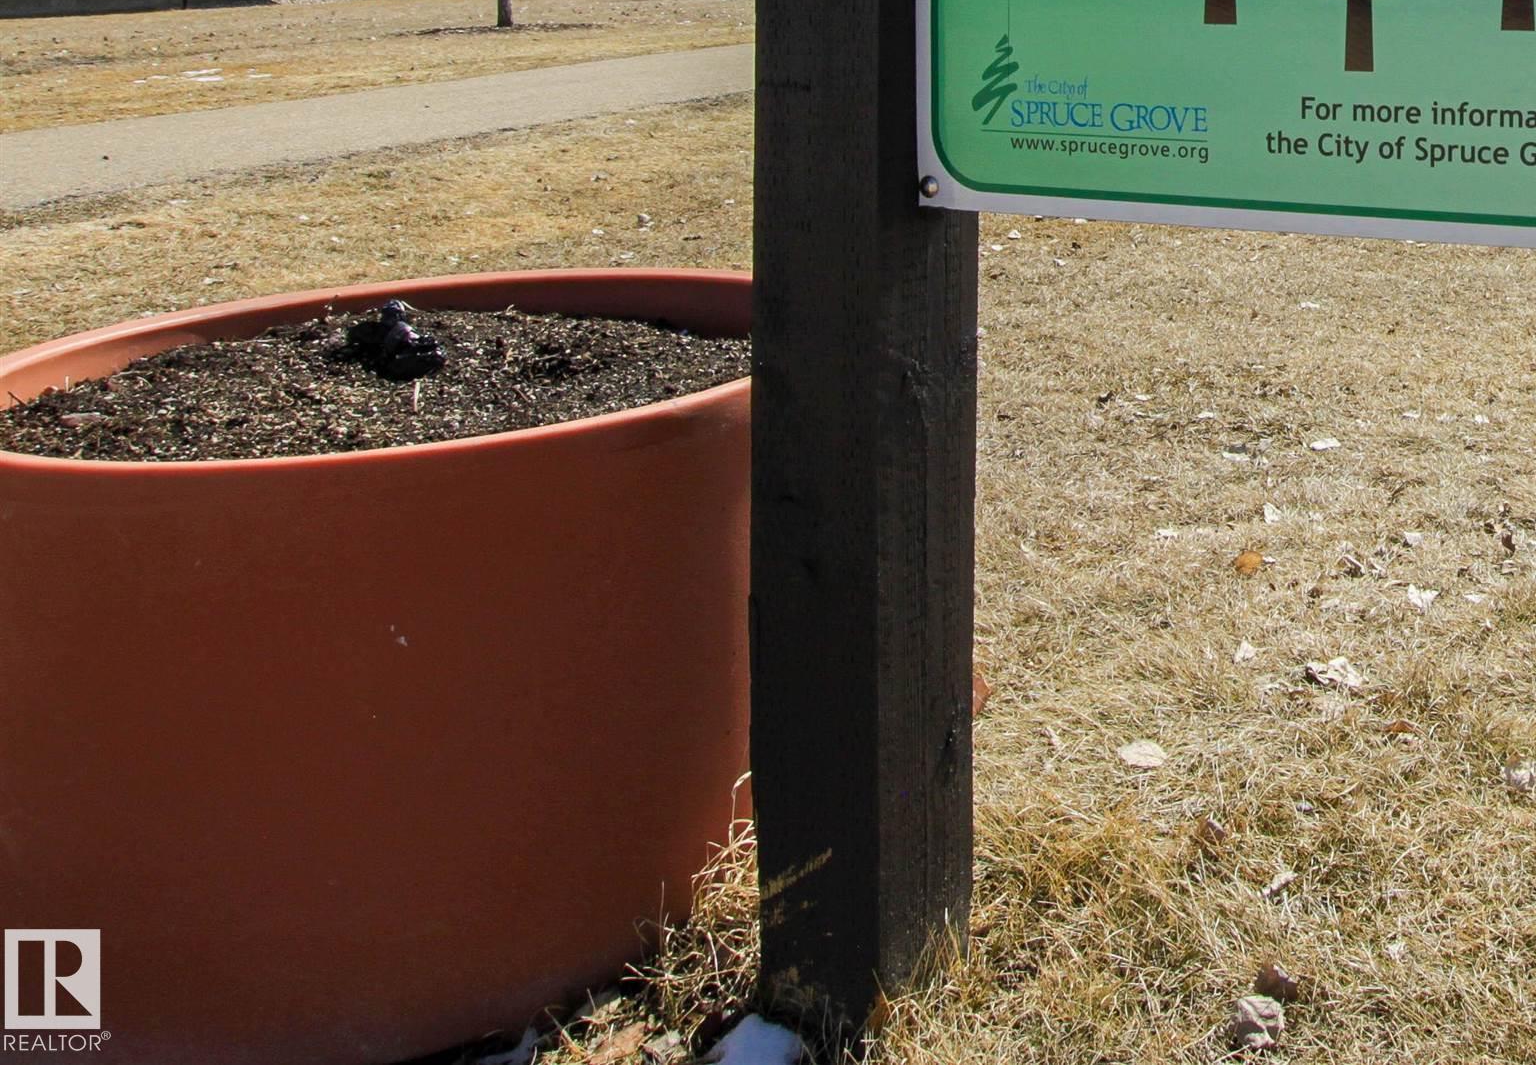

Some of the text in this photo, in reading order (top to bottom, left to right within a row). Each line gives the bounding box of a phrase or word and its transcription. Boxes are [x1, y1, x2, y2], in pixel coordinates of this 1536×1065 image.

[1024, 74, 1088, 100] The City of
[1011, 99, 1208, 133] SPRUCE GROVE
[1300, 96, 1343, 121] For
[1352, 102, 1422, 125] more
[1010, 137, 1209, 164] www.sprucegrove.org
[1265, 131, 1308, 155] the
[1318, 132, 1369, 164] City
[1378, 136, 1405, 161] of
[1414, 137, 1510, 168] Spruce
